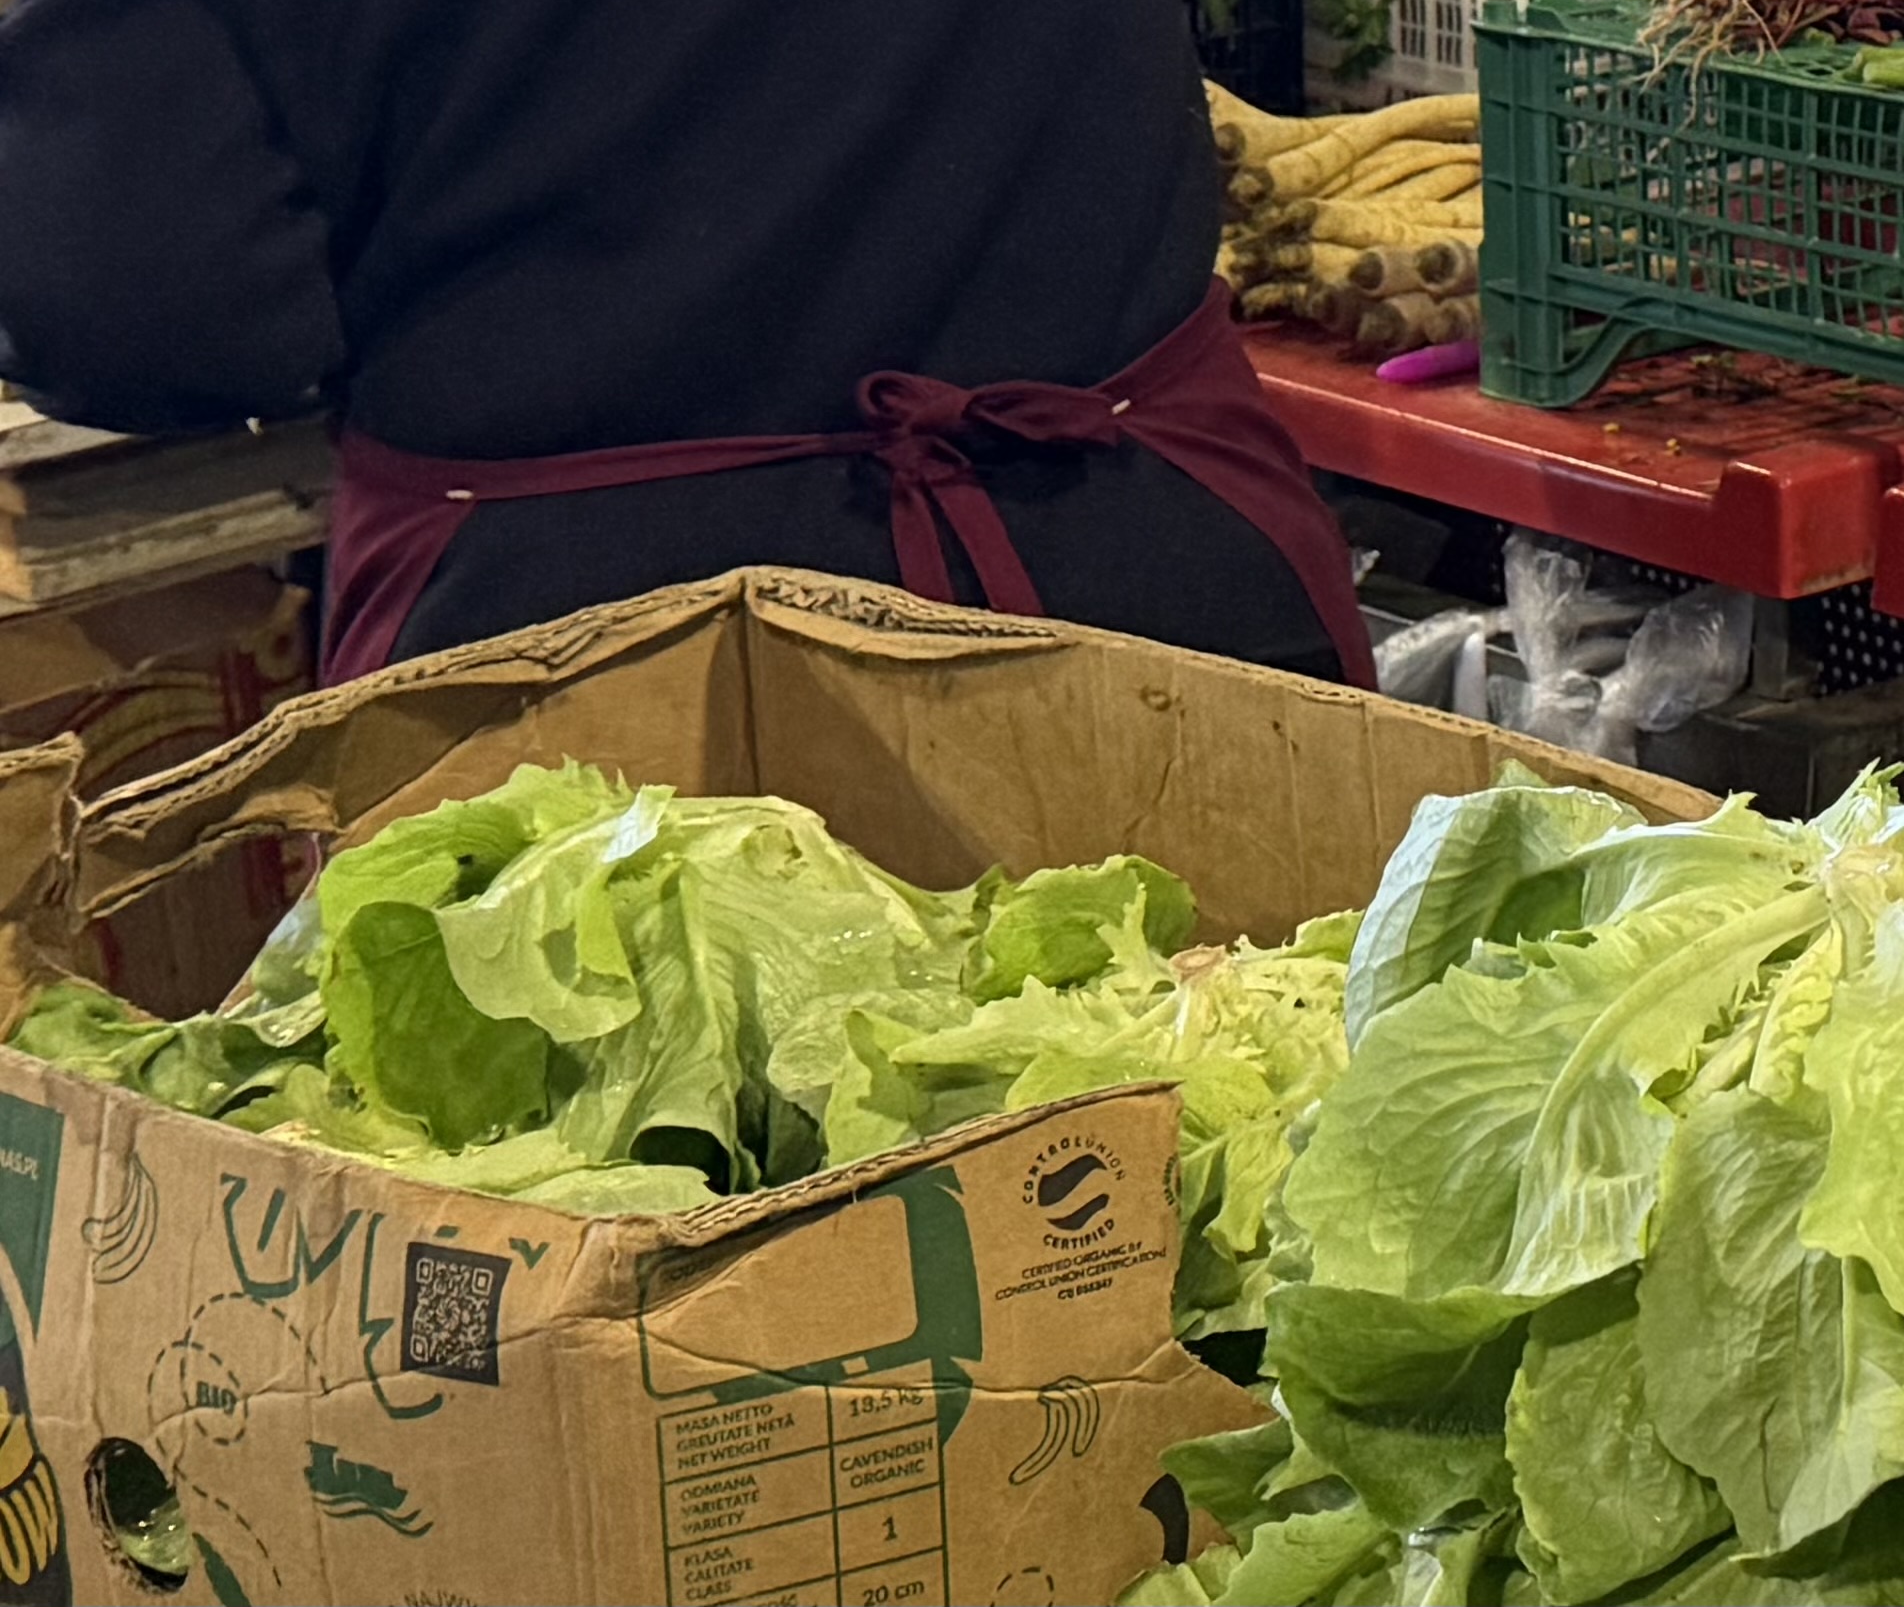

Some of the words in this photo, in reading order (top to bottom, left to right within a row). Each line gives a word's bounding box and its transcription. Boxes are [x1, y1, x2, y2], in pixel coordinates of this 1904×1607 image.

[1022, 1136, 1081, 1205] CONTROL
[1085, 1137, 1127, 1182] UNION
[1042, 1218, 1115, 1251] CERTIFIED
[1021, 1257, 1072, 1280] CERTIFIED
[1073, 1244, 1127, 1267] ORGANIC
[1048, 1270, 1085, 1288] UNION
[195, 1380, 236, 1414] BIO
[675, 1414, 720, 1435] MASA
[722, 1403, 774, 1425] NETTO
[676, 1422, 754, 1452] GREUTATE
[677, 1452, 708, 1470] NET
[709, 1436, 772, 1463] WEIGHT
[840, 1437, 935, 1473] CAVENDISH
[680, 1474, 757, 1502] ODMIANA
[850, 1458, 926, 1489] ORGANIC
[681, 1489, 761, 1518] VARIETATE
[682, 1510, 746, 1535] VARIETY
[881, 1516, 899, 1542] 1
[684, 1546, 734, 1568] KLASA
[684, 1557, 755, 1585] CALITATE
[684, 1579, 733, 1602] CLASS
[861, 1586, 890, 1607] 20
[894, 1579, 926, 1600] cm
